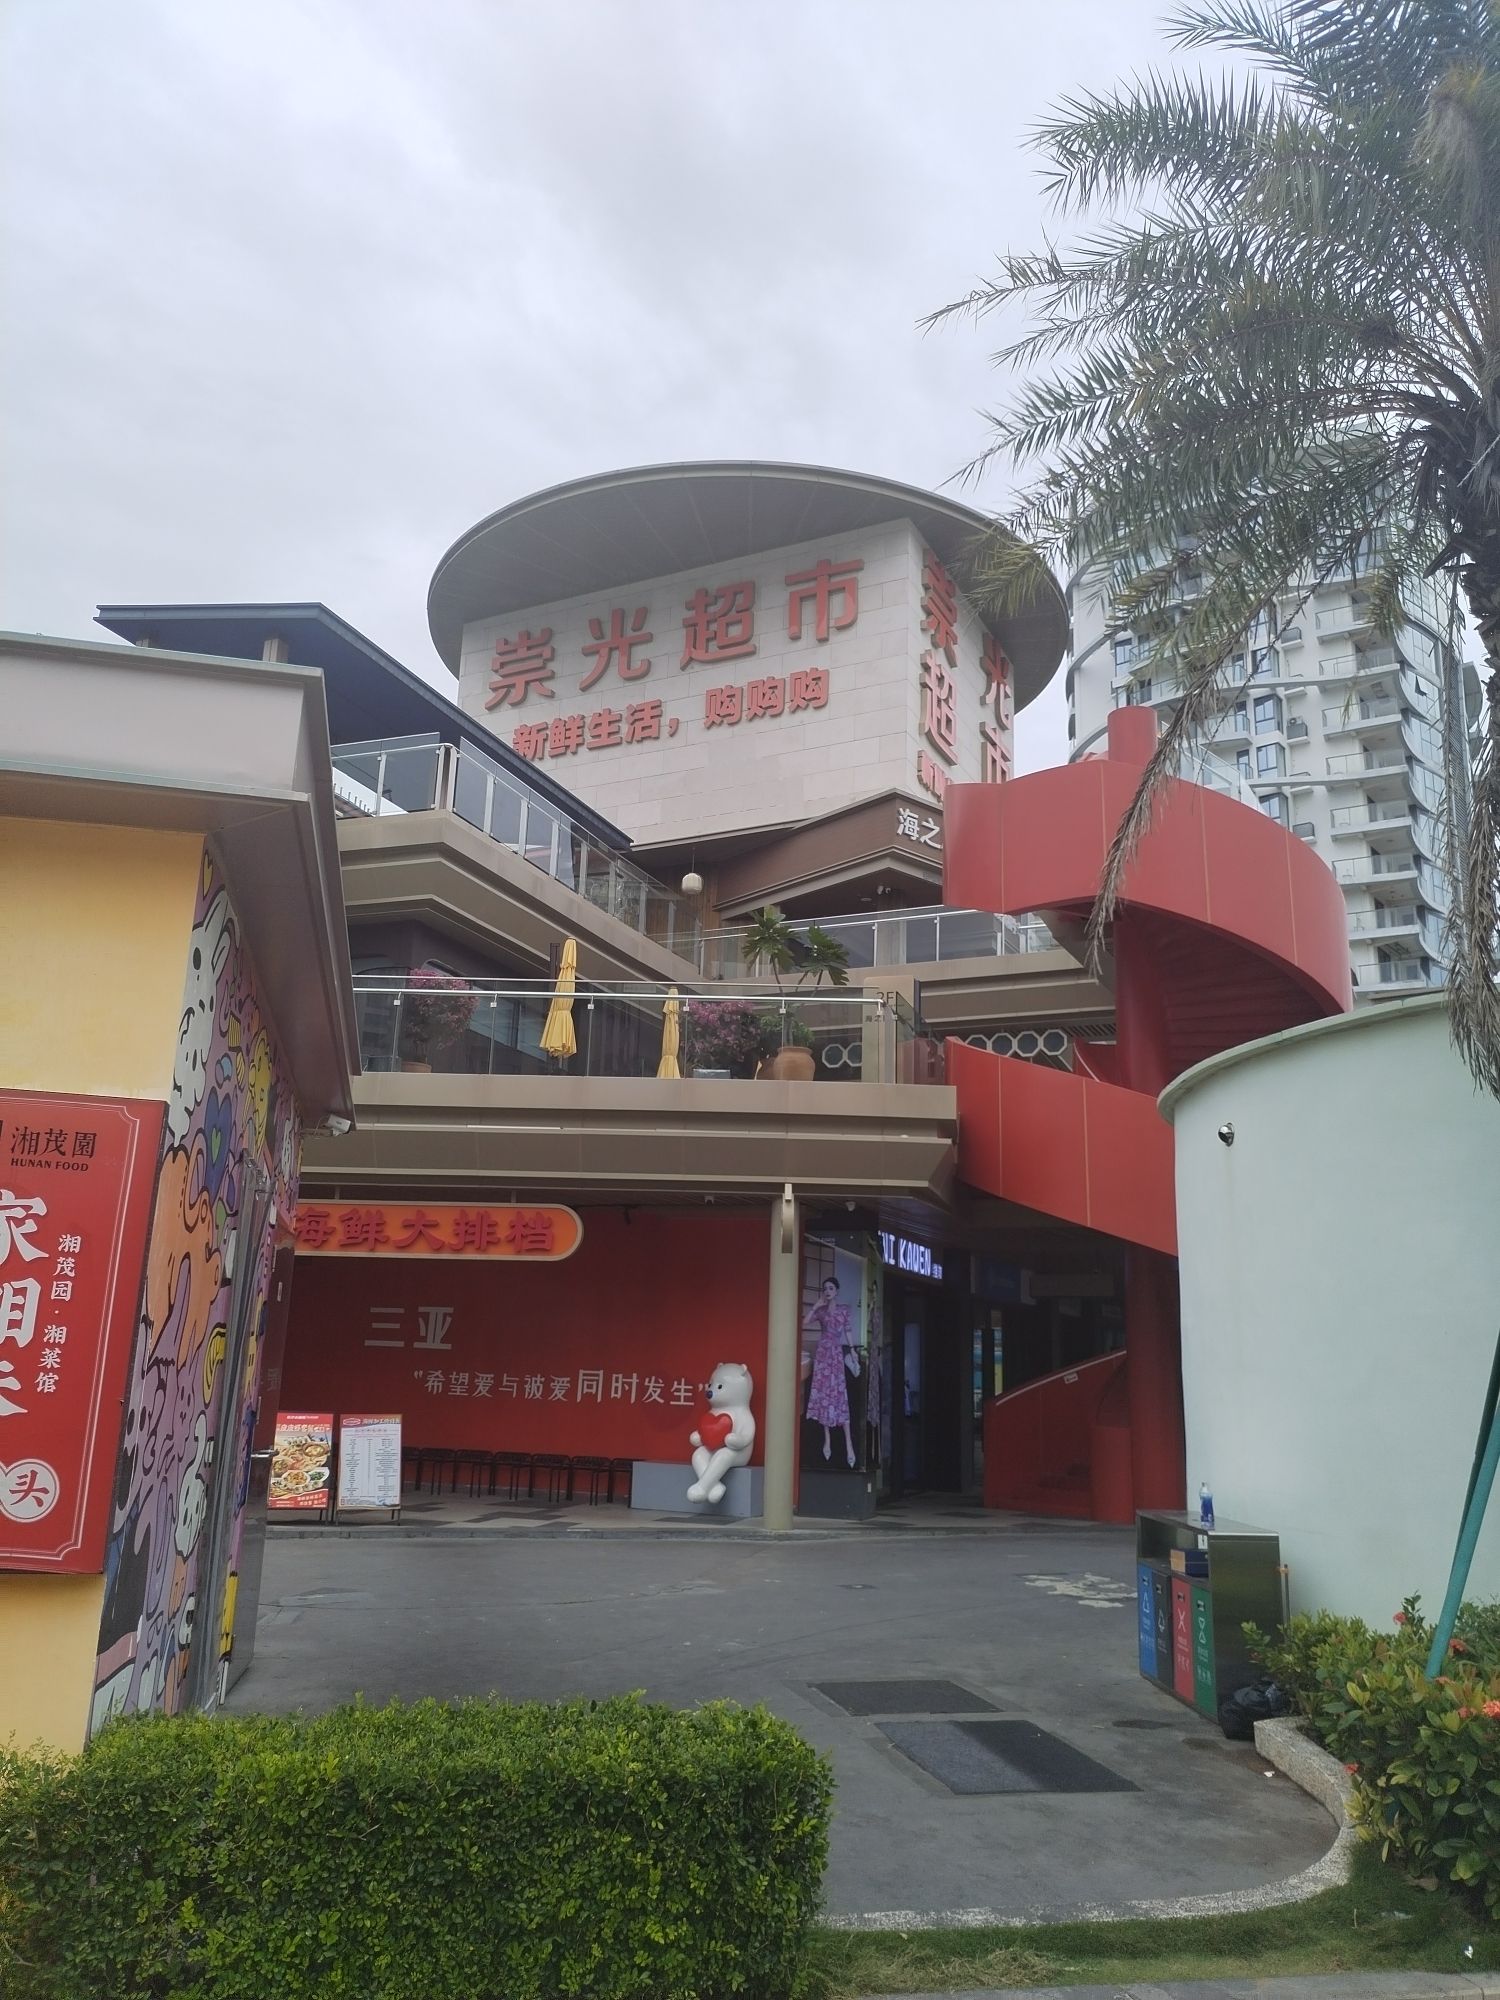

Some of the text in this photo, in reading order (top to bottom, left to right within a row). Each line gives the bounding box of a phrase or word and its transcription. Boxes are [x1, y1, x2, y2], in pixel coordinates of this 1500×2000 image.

[484, 558, 865, 711] 崇光超市
[11, 1126, 97, 1159] 湘茂園
[11, 1158, 89, 1172] HUNAN FOOD
[294, 1206, 555, 1252] 海鲜大排档
[364, 1306, 454, 1350] 三亚
